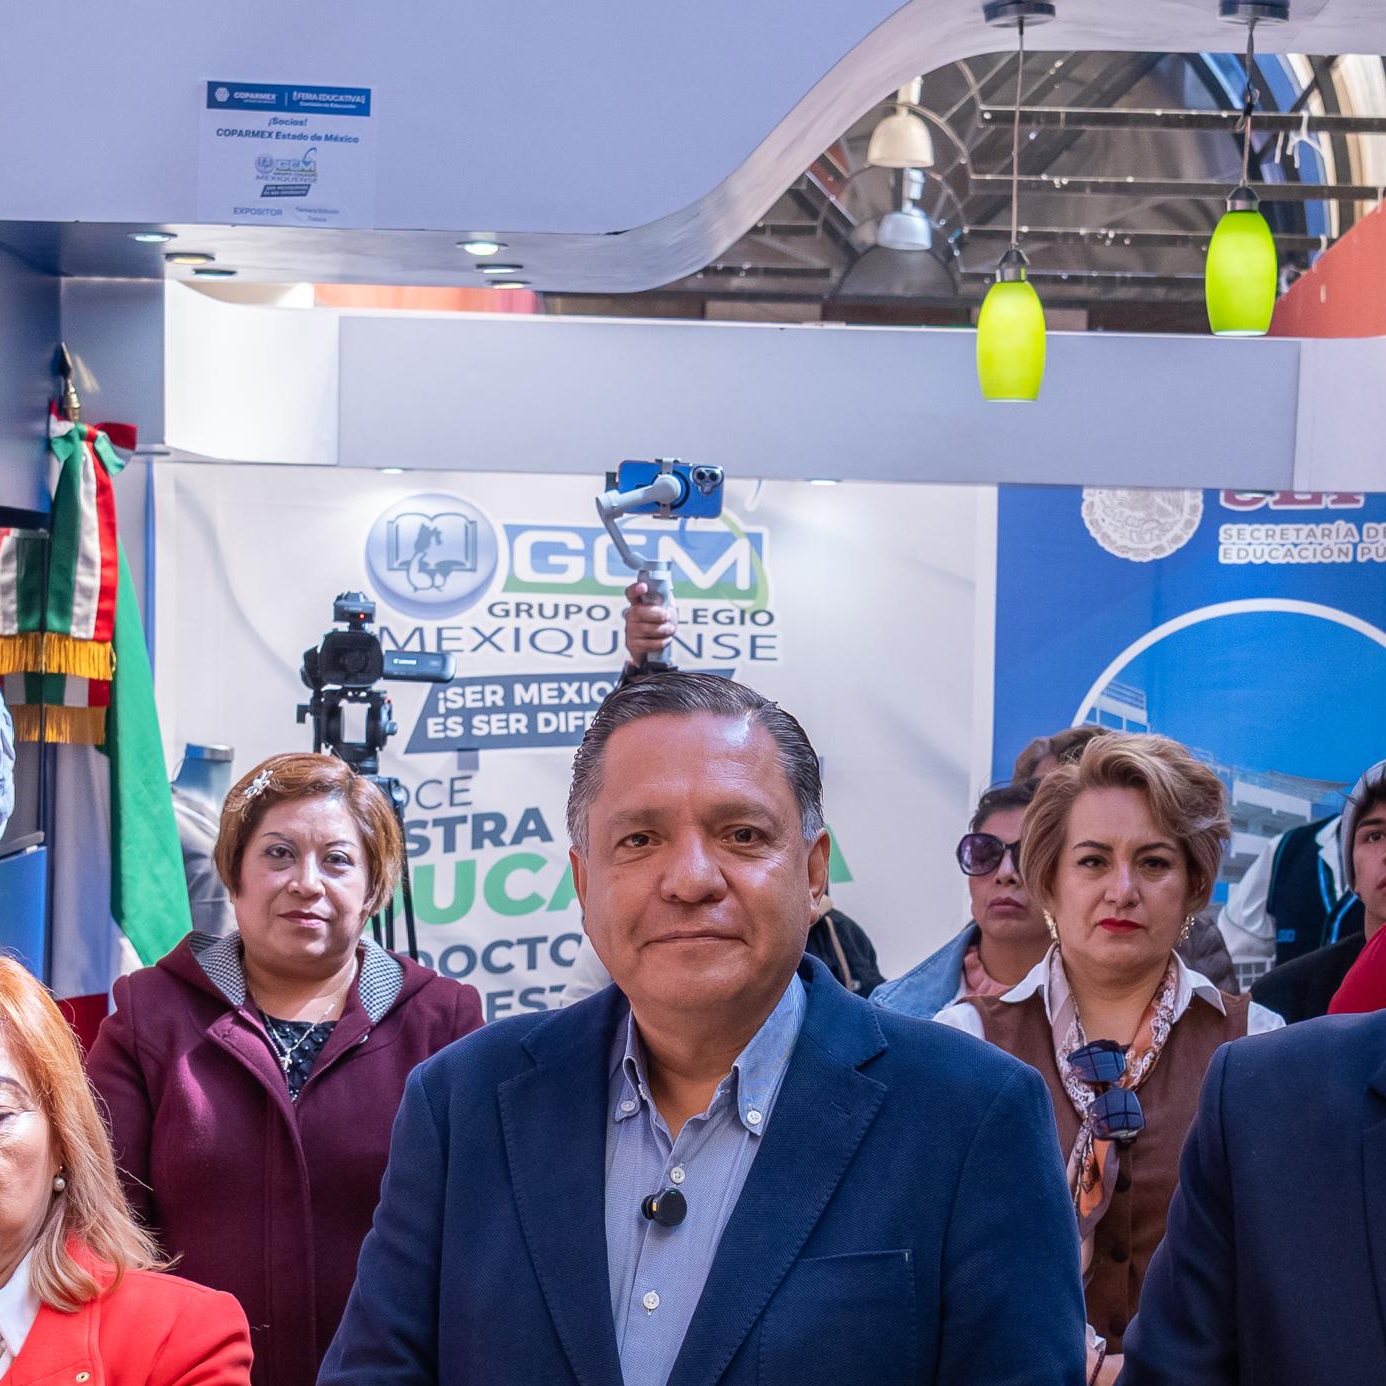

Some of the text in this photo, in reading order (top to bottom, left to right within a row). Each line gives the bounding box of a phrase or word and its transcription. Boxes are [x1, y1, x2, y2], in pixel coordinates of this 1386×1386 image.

[216, 128, 359, 144] COPARMEX Estado de México
[233, 207, 283, 216] EXPOSITOR
[1221, 522, 1358, 542] SECRETARÍA
[513, 530, 751, 590] GCM
[1221, 544, 1352, 562] EDUCACIÓN
[487, 601, 611, 622] GRUPO
[380, 625, 779, 661] MEXIQUNSE
[437, 684, 506, 715] ¡SER
[426, 716, 464, 739] ES
[471, 713, 529, 736] SER
[405, 806, 554, 858] STRA
